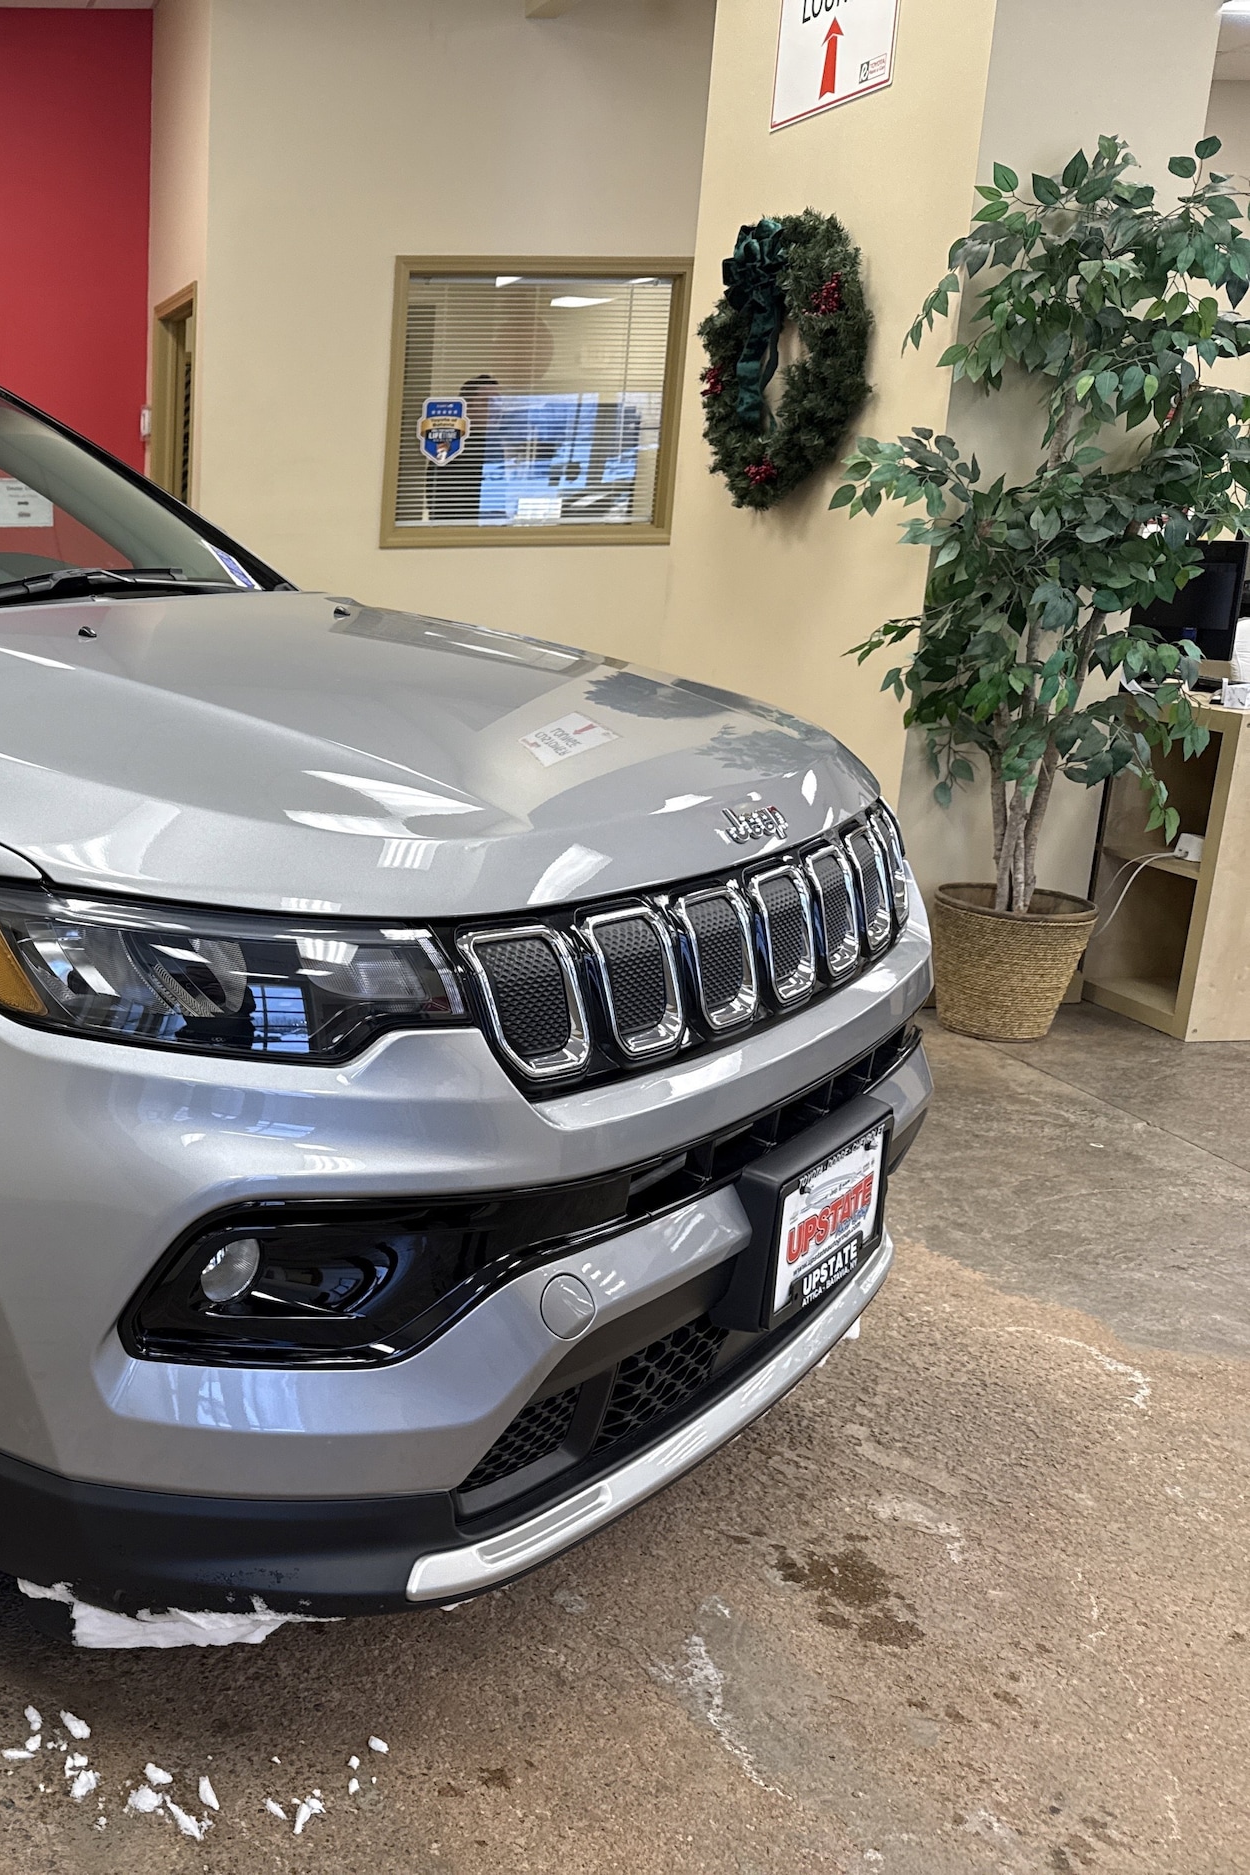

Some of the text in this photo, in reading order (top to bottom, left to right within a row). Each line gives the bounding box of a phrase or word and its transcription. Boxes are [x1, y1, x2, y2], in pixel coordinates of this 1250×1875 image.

[721, 805, 789, 844] Jeep
[786, 1172, 874, 1264] UPSTATE
[803, 1238, 858, 1296] UPSTATE
[801, 1286, 823, 1308] ATTICA
